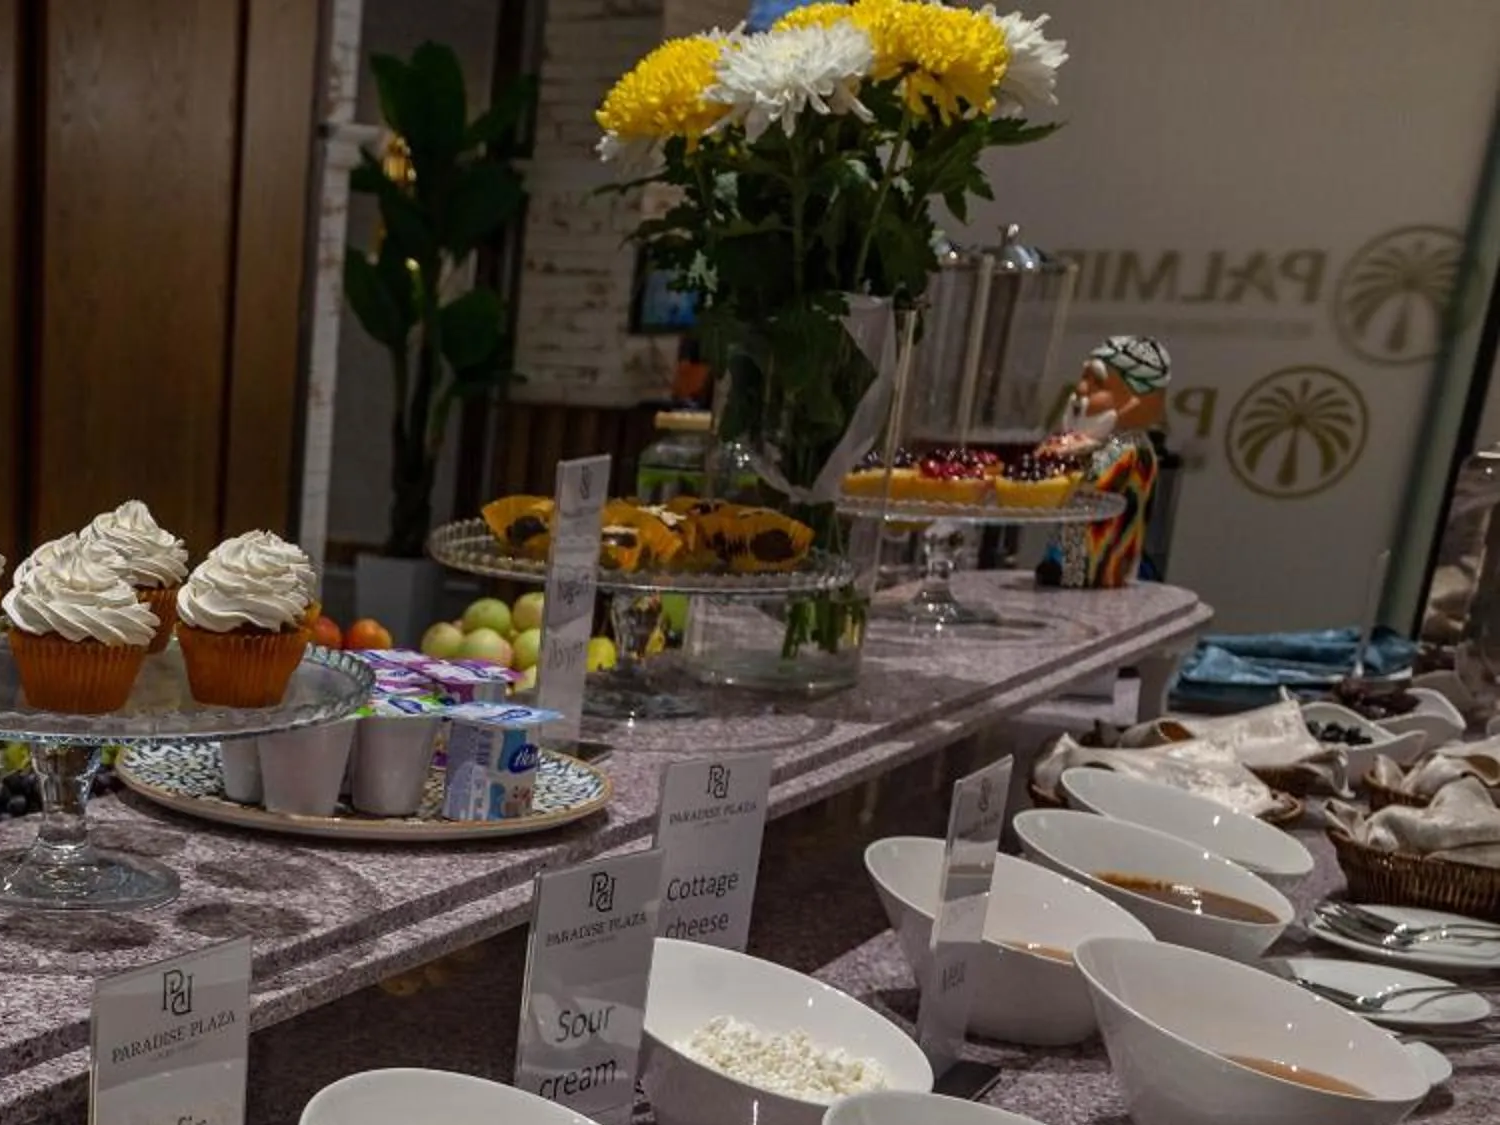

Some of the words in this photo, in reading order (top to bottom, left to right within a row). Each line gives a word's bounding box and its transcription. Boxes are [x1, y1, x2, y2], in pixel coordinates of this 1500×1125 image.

[666, 873, 739, 902] Cottage
[665, 913, 729, 939] cheese
[111, 1026, 185, 1064] PARADISE
[189, 1010, 236, 1037] PLAZA
[555, 1004, 617, 1043] Sour
[540, 1059, 617, 1100] cream
